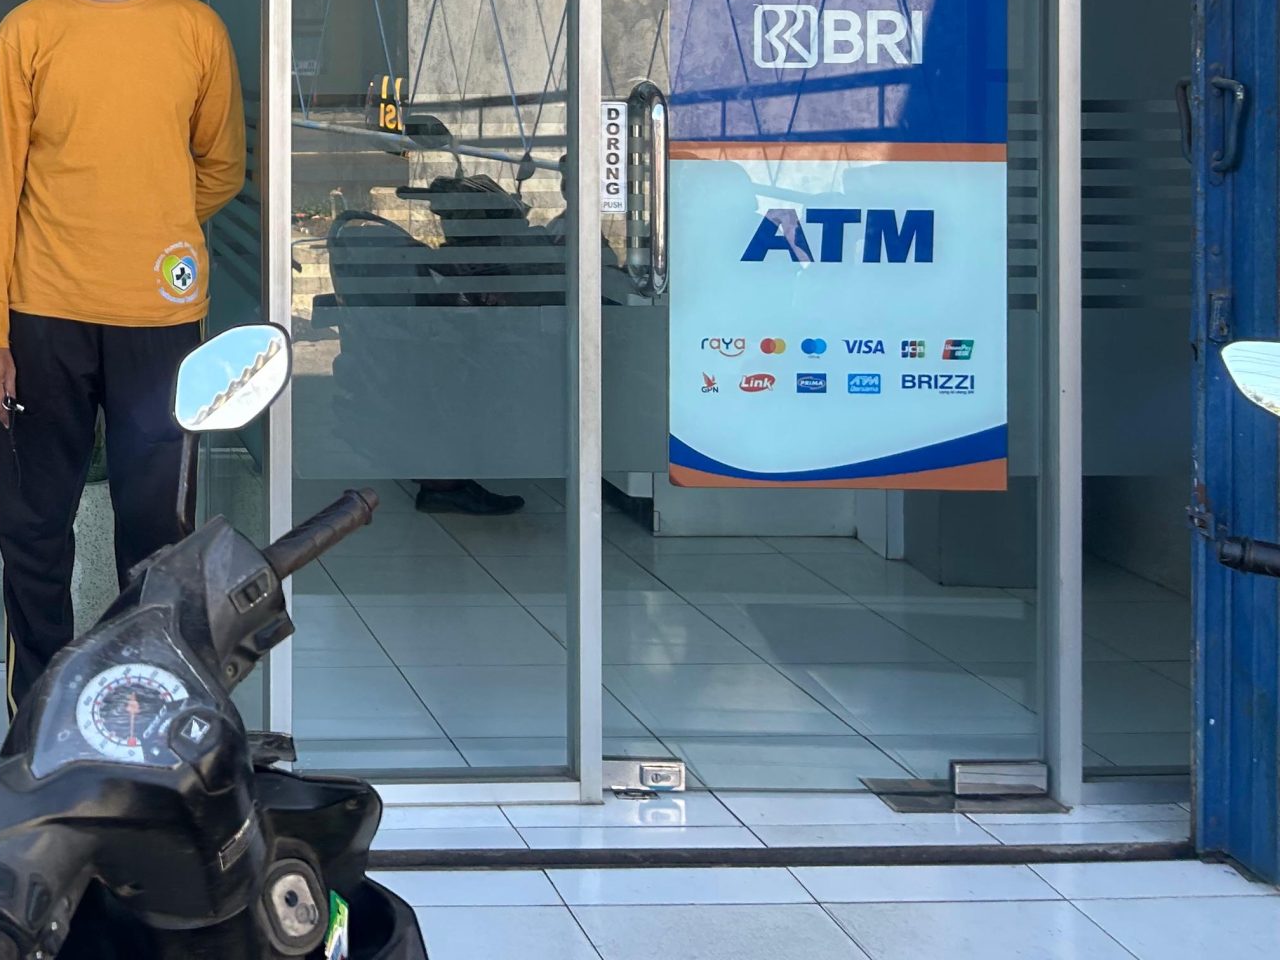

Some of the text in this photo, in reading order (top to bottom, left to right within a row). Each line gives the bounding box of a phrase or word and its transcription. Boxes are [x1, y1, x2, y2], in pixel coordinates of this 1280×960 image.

[823, 9, 923, 64] BRI
[605, 107, 620, 196] DORONG
[603, 201, 622, 209] PUSH
[740, 208, 935, 263] ATM
[842, 339, 885, 354] VISA
[741, 375, 773, 390] Link
[850, 375, 879, 386] ATM
[901, 374, 975, 390] BRIZZI
